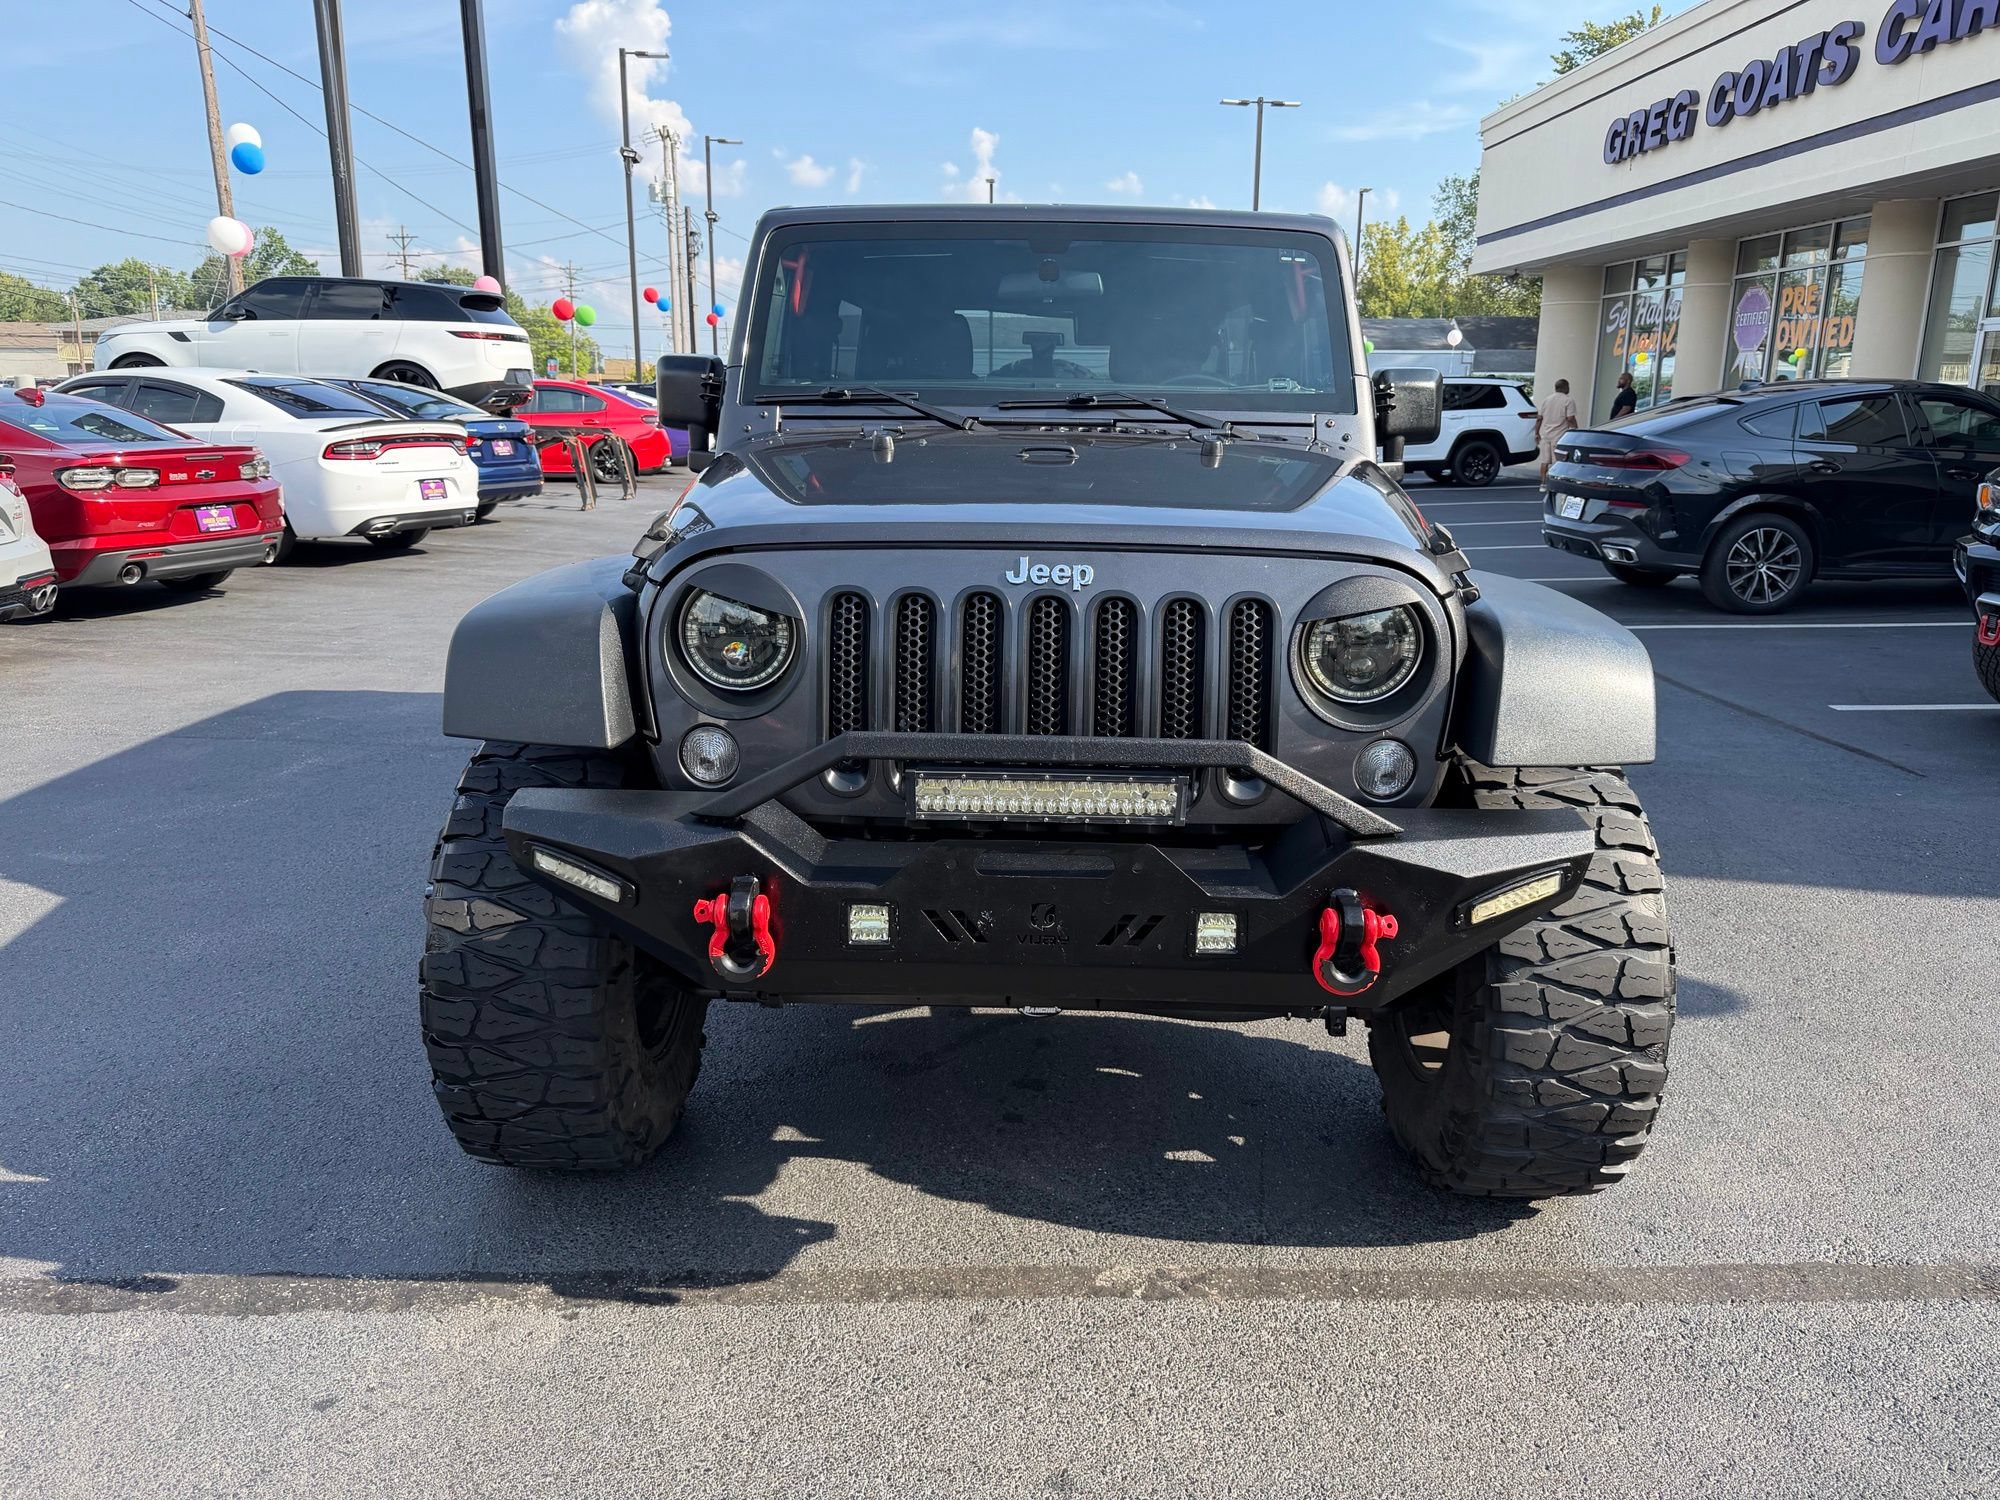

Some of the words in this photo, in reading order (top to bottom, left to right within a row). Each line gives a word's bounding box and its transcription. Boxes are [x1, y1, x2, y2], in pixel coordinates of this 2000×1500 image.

[1604, 89, 1700, 165] GREG
[1705, 20, 1866, 128] COATS
[1606, 300, 1628, 333] Se
[1779, 284, 1819, 316] PRE
[1735, 311, 1768, 327] CERTIFIED
[1776, 315, 1854, 352] OWNED
[1005, 556, 1094, 591] Jeep
[1024, 1006, 1057, 1014] RANCHO
